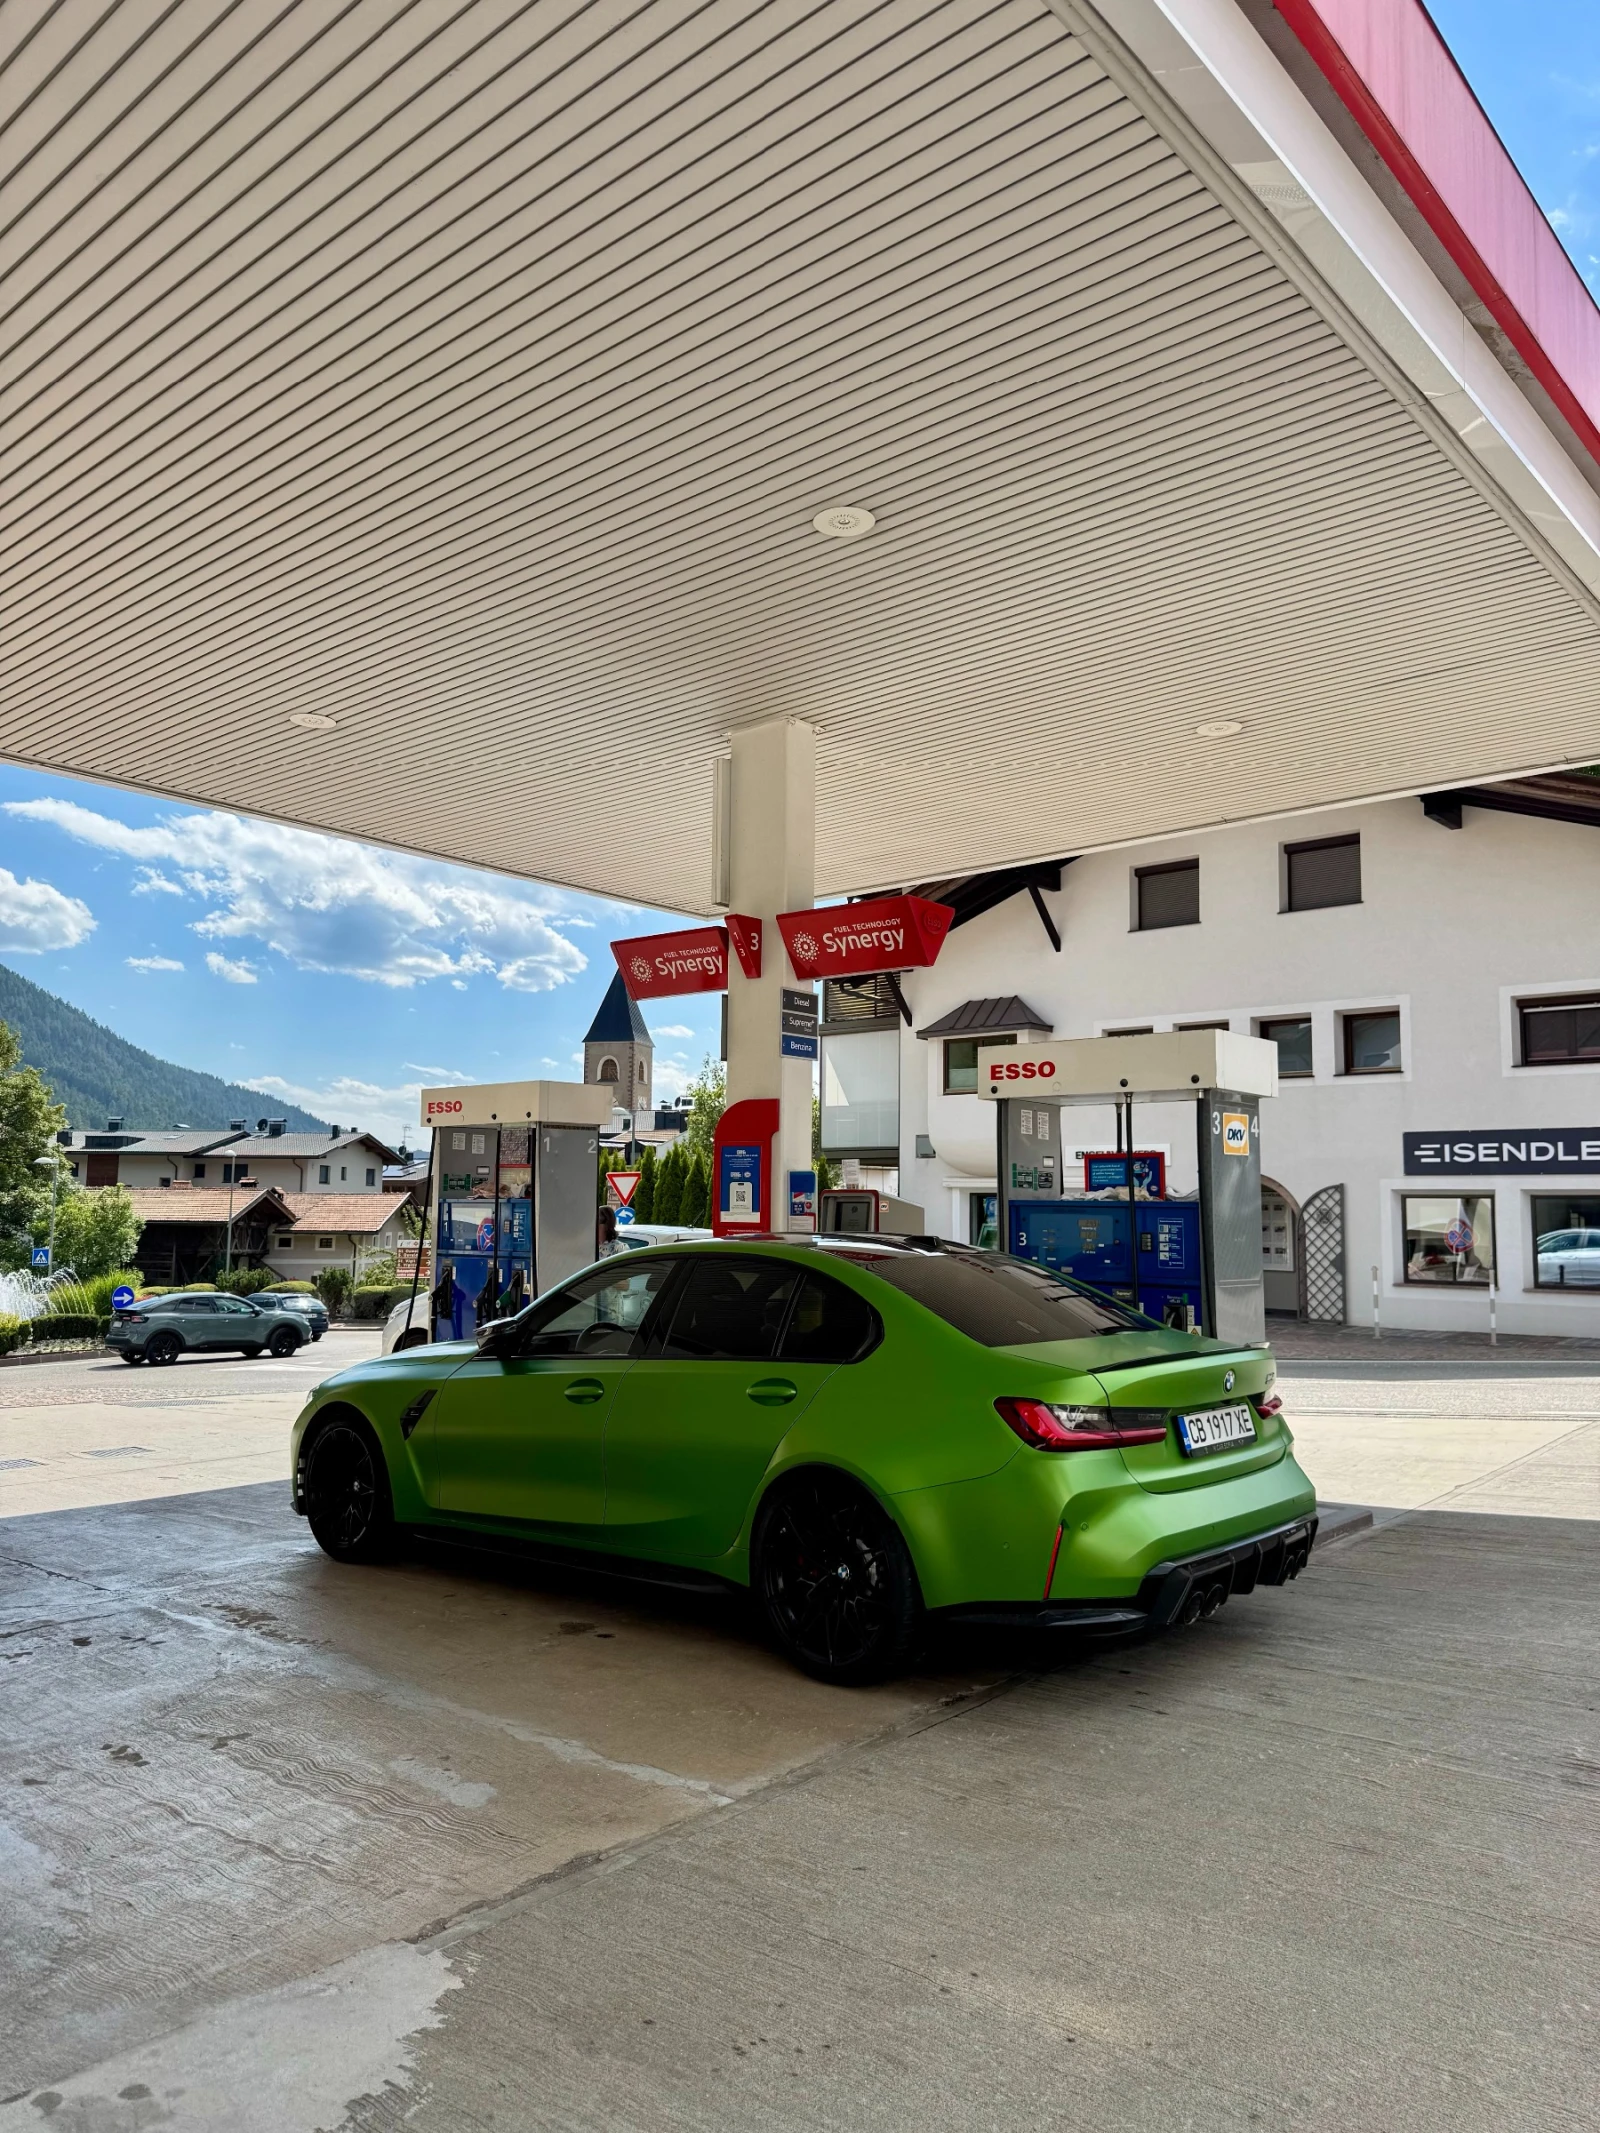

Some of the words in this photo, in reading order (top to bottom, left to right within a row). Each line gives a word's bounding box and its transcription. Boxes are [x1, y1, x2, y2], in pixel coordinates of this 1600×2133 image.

[833, 925, 851, 934] FUEL
[852, 918, 901, 932] TECHNOLOGY
[733, 931, 739, 940] 1
[740, 948, 746, 957] 3
[750, 932, 759, 951] 3
[822, 928, 904, 957] Synergy
[679, 946, 719, 957] TECHNOLOGY
[655, 955, 723, 979] Synergy
[794, 996, 810, 1007] Diesel
[790, 1041, 812, 1052] Benzina
[990, 1061, 1056, 1081] ESSO
[427, 1100, 463, 1114] ESSO
[1212, 1111, 1221, 1135] 3
[1250, 1115, 1259, 1138] 4
[1227, 1128, 1246, 1142] DKV
[543, 1137, 550, 1153] 1
[587, 1138, 597, 1154] 2
[1414, 1140, 1600, 1163] EISENDLE
[443, 1221, 448, 1232] 1
[1018, 1232, 1027, 1246] 3
[1188, 1417, 1207, 1444] CB
[1206, 1411, 1233, 1440] 1917
[1233, 1408, 1253, 1435] XE
